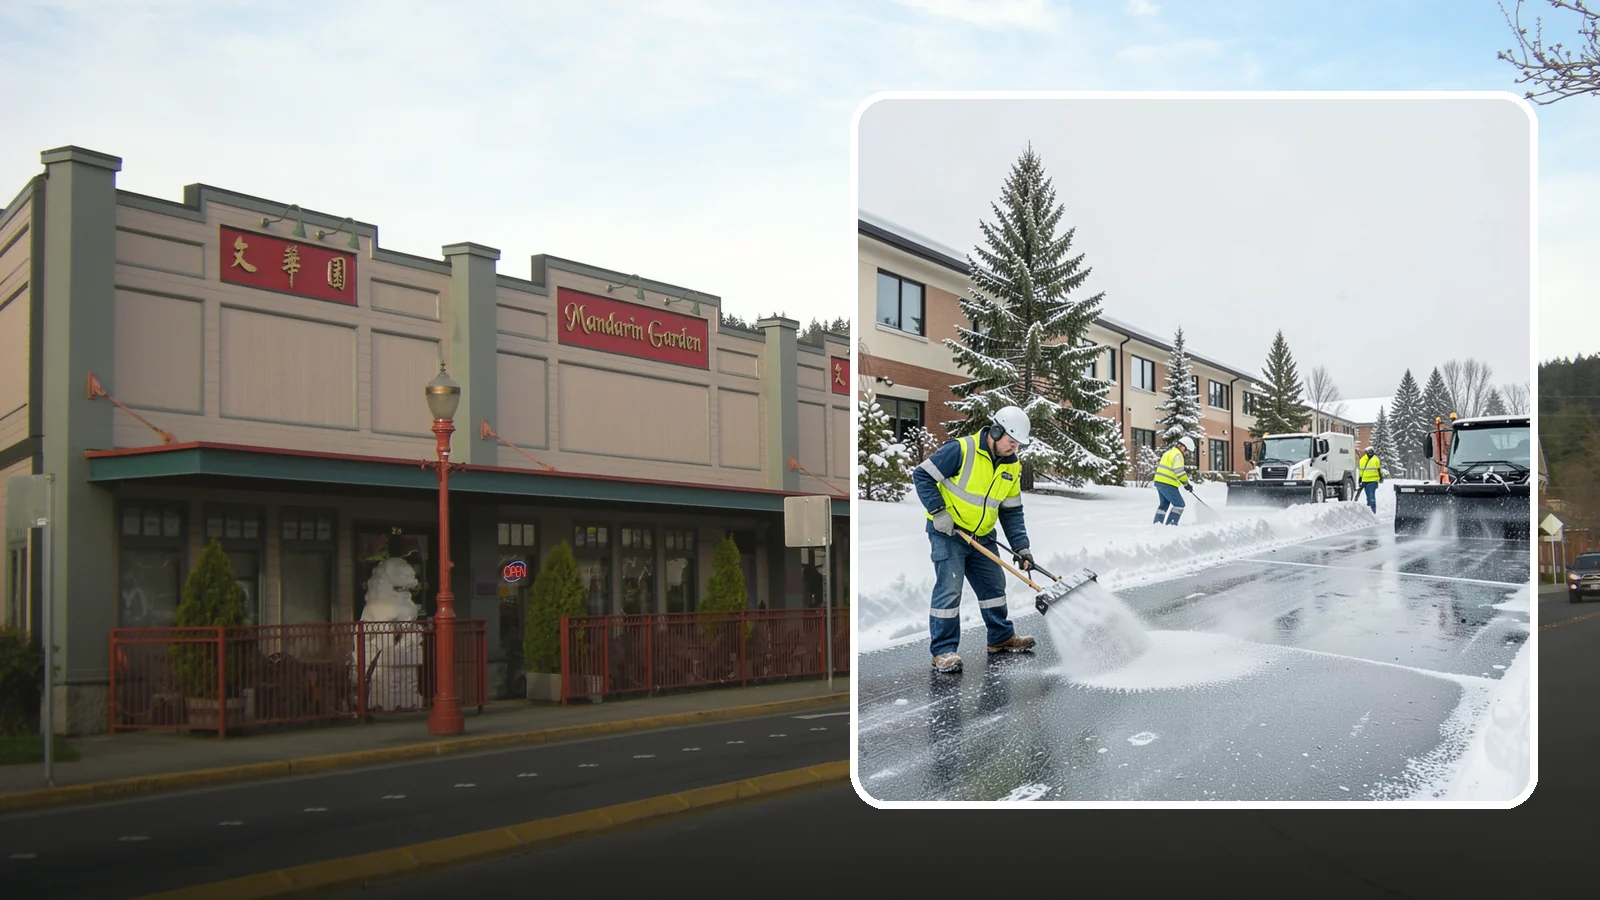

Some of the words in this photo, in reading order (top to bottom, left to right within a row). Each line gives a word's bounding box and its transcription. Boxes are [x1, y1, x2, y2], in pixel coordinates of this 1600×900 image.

[231, 235, 347, 290] 文華園
[565, 302, 643, 340] Mandarin
[648, 320, 701, 352] Garden
[503, 565, 527, 578] OPEN
